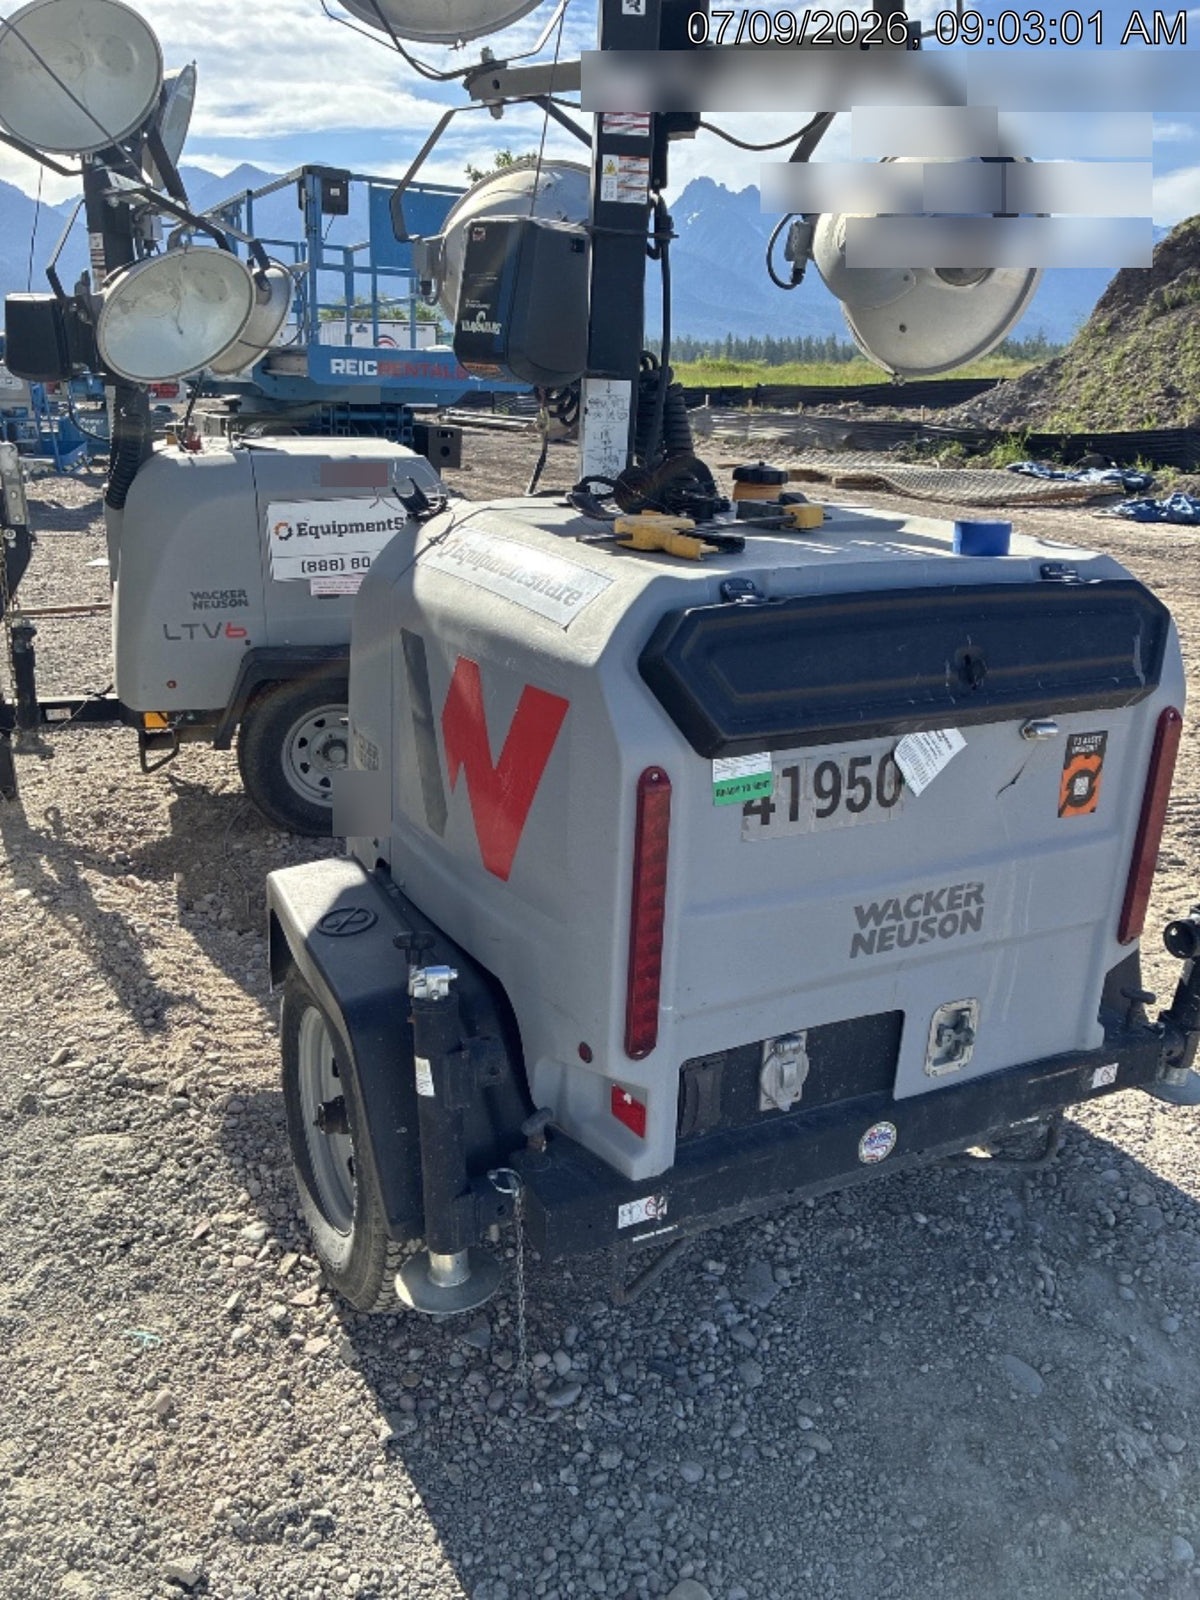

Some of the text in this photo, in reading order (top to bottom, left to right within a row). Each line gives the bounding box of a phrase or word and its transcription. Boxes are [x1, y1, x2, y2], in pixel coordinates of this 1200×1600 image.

[301, 558, 345, 574] (888)
[190, 589, 247, 601] WACKER
[192, 599, 249, 610] NEUSON
[163, 621, 247, 641] LTV6
[853, 881, 985, 930] WACKER
[849, 906, 984, 959] NEUSON
